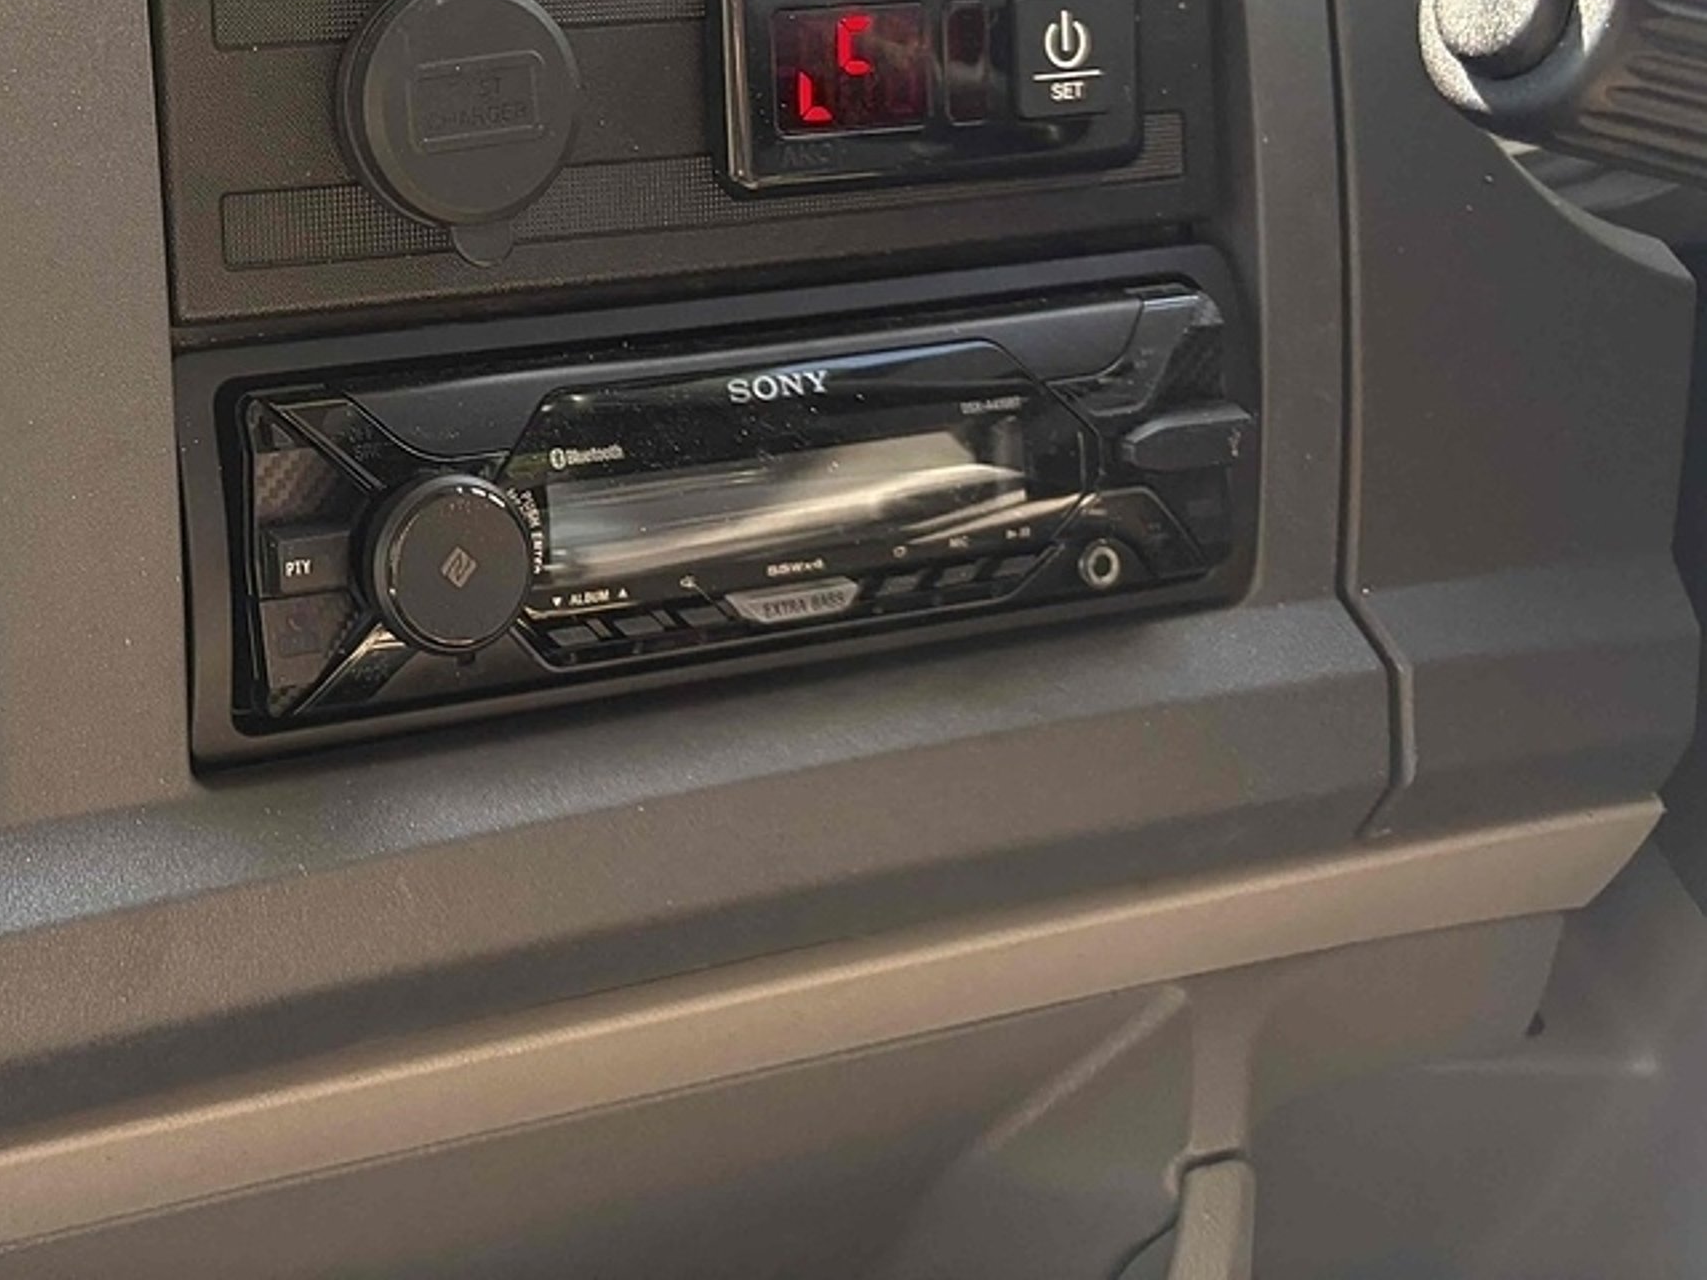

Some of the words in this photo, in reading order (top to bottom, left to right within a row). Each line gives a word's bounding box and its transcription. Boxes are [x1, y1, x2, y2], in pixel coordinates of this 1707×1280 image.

[1050, 82, 1085, 101] SET
[727, 370, 828, 403] SONY
[285, 558, 311, 576] PTY
[569, 588, 610, 606] ALBUM
[763, 597, 807, 618] EXTRA
